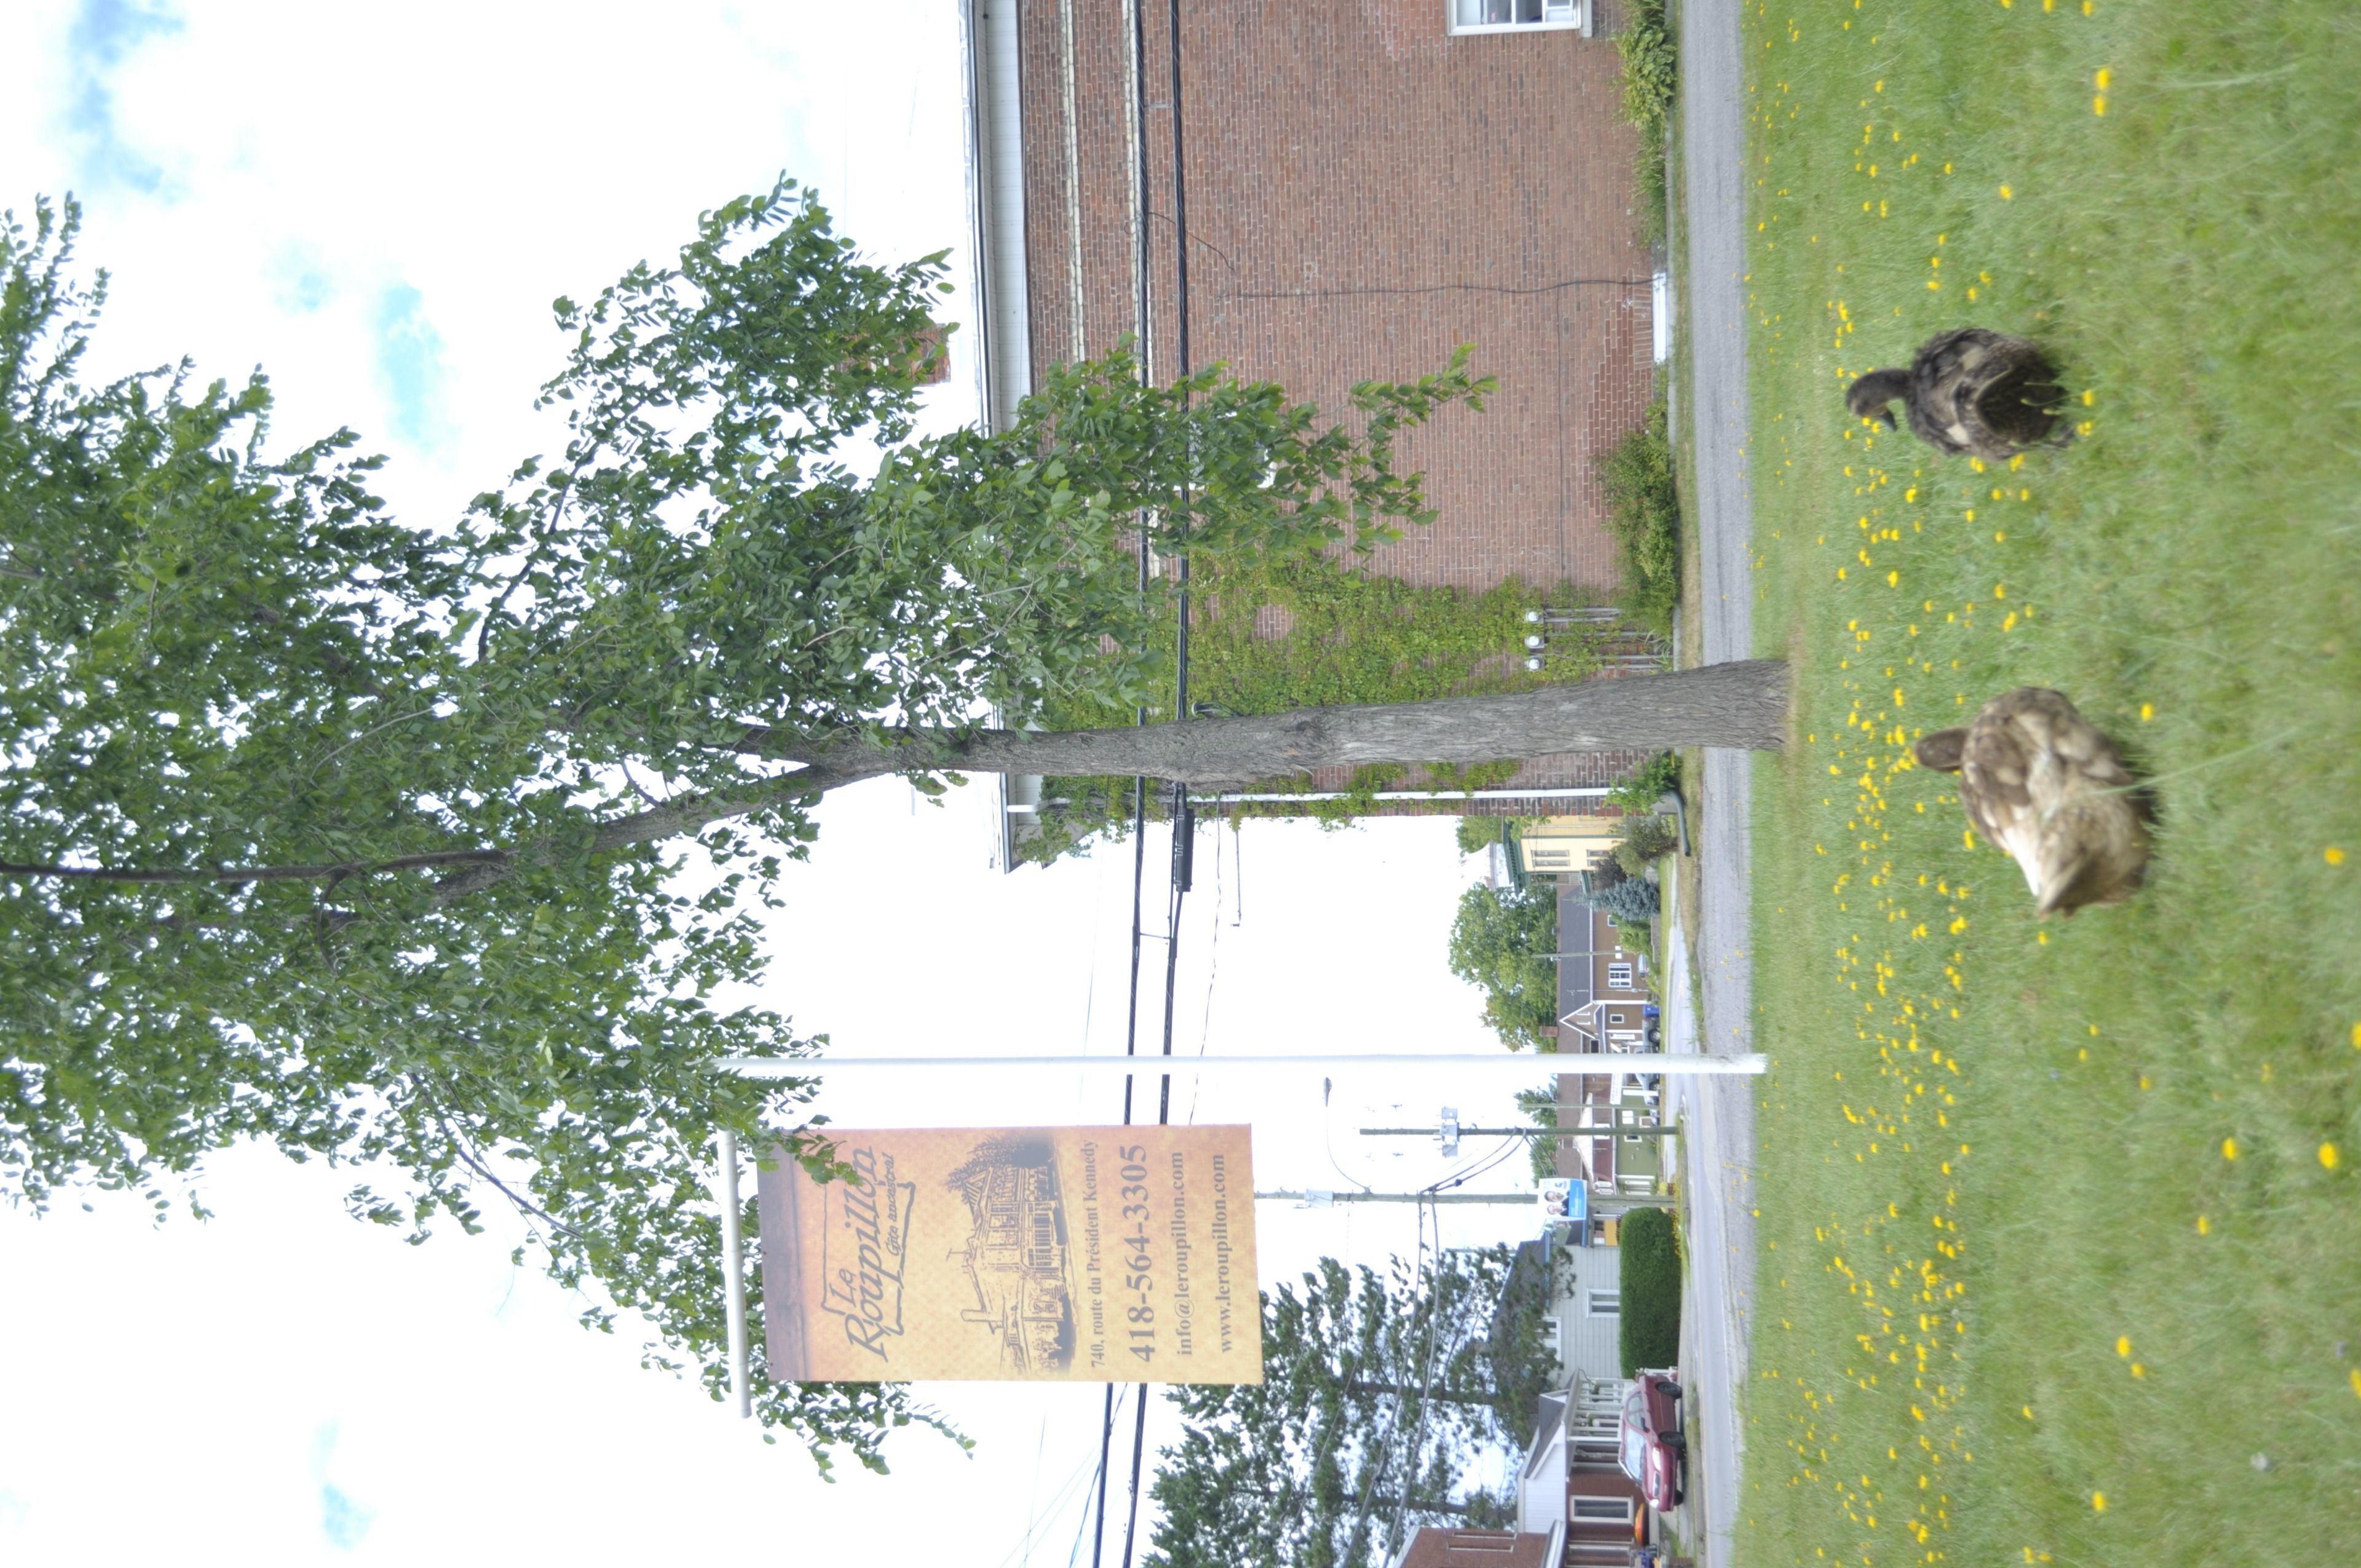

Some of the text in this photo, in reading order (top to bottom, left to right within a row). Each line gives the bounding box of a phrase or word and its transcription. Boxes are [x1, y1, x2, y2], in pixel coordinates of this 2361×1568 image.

[828, 1268, 856, 1307] Le
[844, 1146, 904, 1363] Roupillon
[882, 1152, 897, 1222] ancestral
[1080, 1139, 1105, 1368] 740, route du Président Kennedy
[1119, 1145, 1156, 1363] 418-564-3305
[1171, 1152, 1195, 1355] info@leroupillon.com
[1211, 1154, 1233, 1353] www.leroupillon.com
